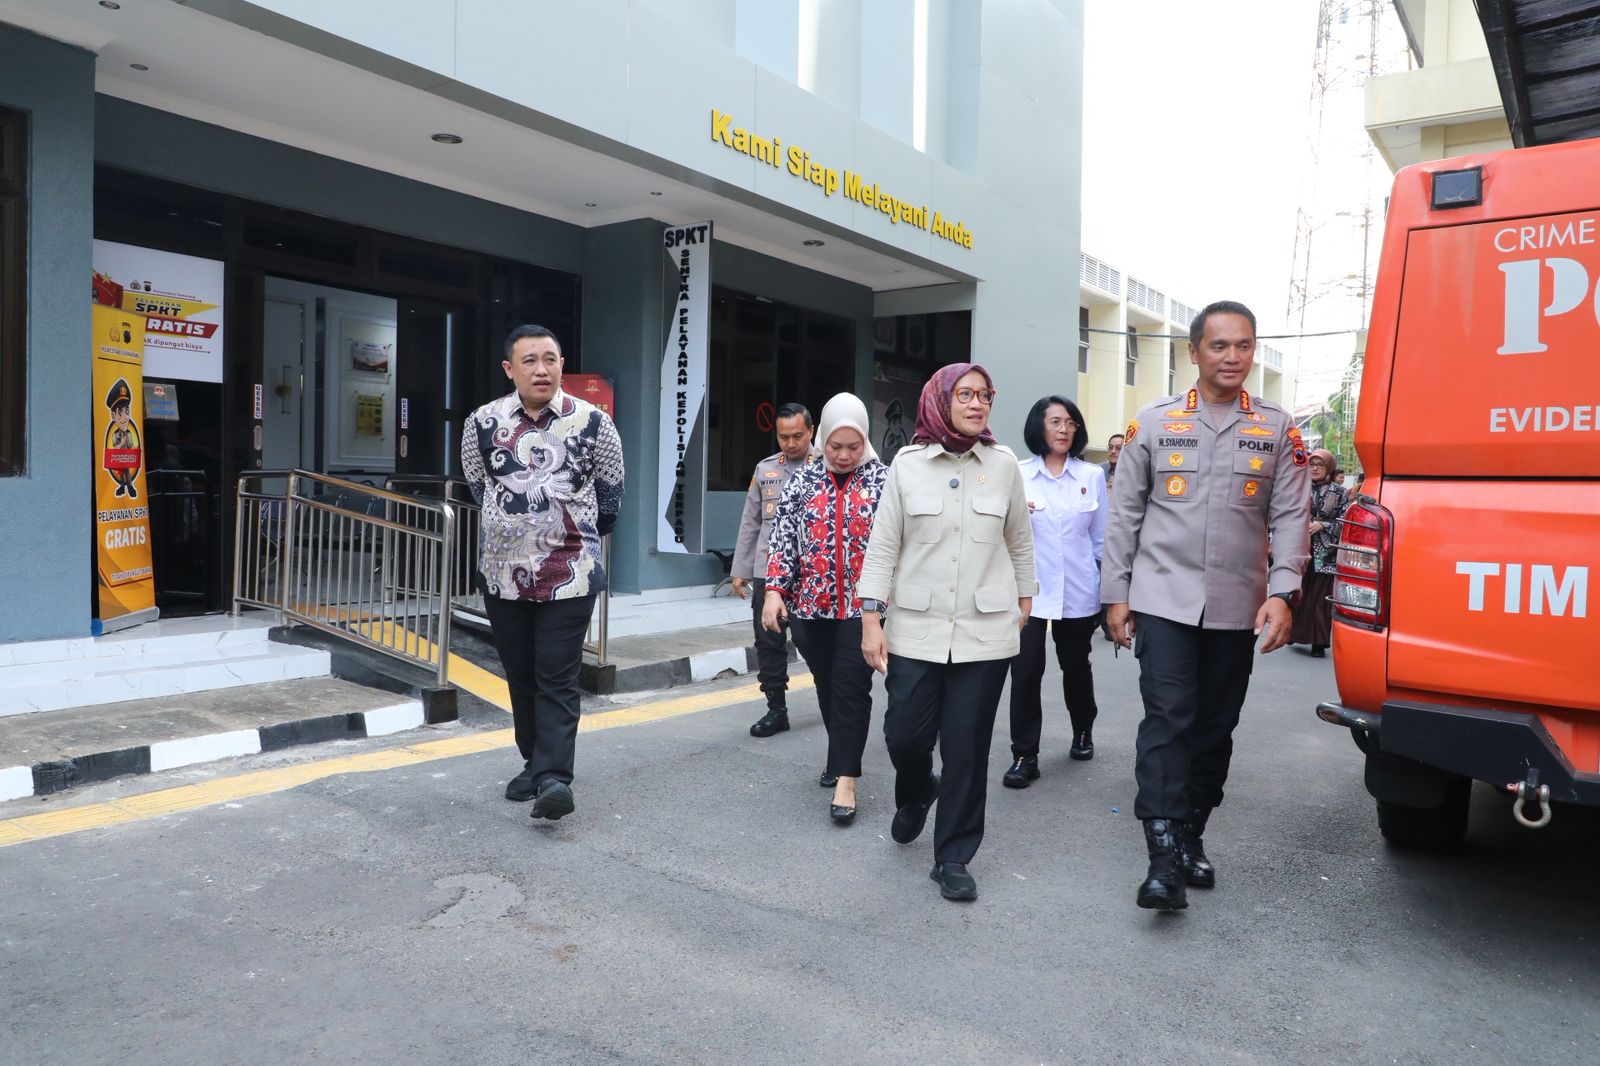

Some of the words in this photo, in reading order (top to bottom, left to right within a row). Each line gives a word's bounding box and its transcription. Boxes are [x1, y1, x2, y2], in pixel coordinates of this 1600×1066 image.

[711, 108, 781, 168] Kami
[787, 145, 839, 197] Siap
[844, 169, 929, 230] Melayani
[931, 211, 973, 249] Anda
[665, 225, 708, 248] SPKT
[1494, 219, 1595, 252] CRIME
[679, 249, 690, 300] SENTRA
[135, 303, 182, 316] SPKT
[1496, 257, 1600, 355] P
[147, 318, 205, 336] RATIS
[153, 339, 184, 348] dipungut
[185, 342, 203, 350] biaya
[677, 308, 689, 385] PELAYANAN
[676, 391, 687, 477] KEPOLISIAN
[1239, 439, 1273, 452] POLRI
[98, 508, 133, 522] PELAYANAN
[674, 484, 685, 543] TERPADU
[105, 526, 146, 549] GRATIS
[1456, 561, 1588, 618] TIM
